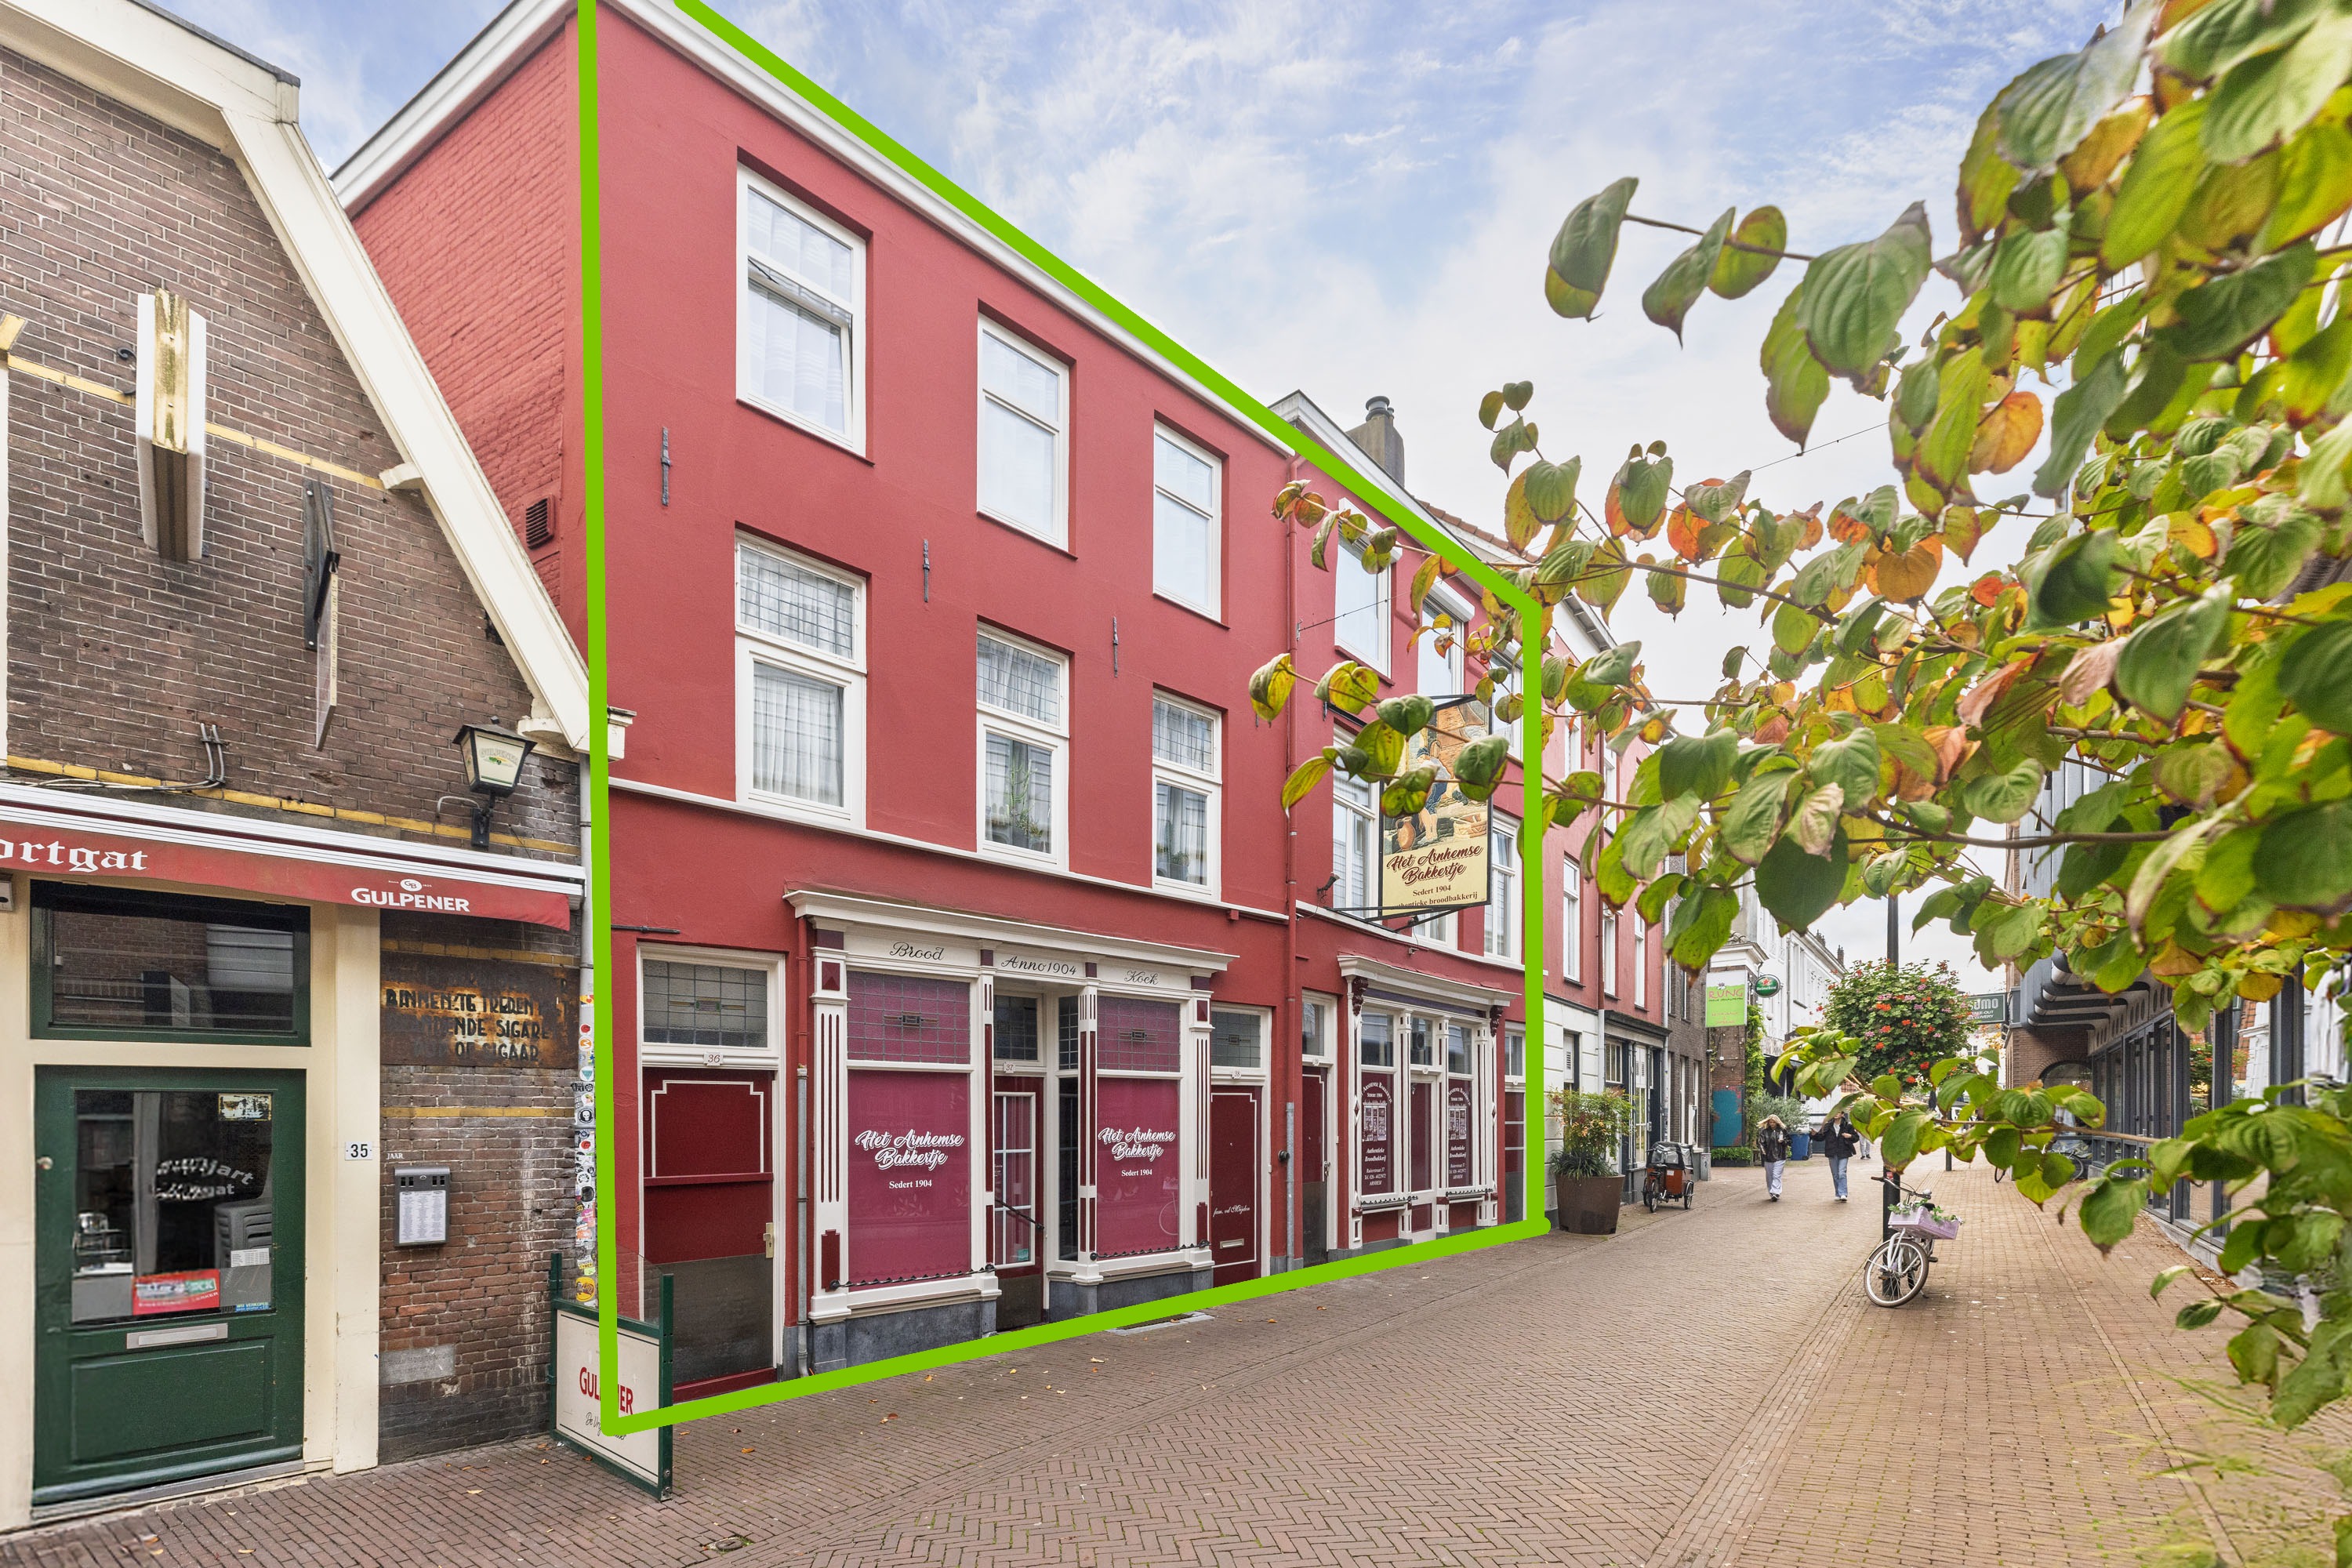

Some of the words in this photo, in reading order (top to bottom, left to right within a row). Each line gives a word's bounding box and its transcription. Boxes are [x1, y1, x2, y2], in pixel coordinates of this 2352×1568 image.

[1387, 855, 1416, 872] Het
[1417, 845, 1484, 867] Arnhemse
[1402, 862, 1467, 887] Bakkertje
[1413, 888, 1434, 897] Sedert
[1436, 885, 1451, 894] 1904
[1429, 891, 1478, 905] broodbakkerij
[351, 887, 470, 912] GULPENER
[890, 942, 944, 961] Brood
[1047, 962, 1076, 975] 1904
[1124, 971, 1159, 985] Koek
[1708, 988, 1744, 1000] RUNG
[707, 1054, 720, 1063] 36
[855, 1130, 892, 1151] Het
[893, 1129, 964, 1150] Arnhemse
[1098, 1127, 1123, 1145] Het
[1124, 1127, 1176, 1144] Arnhemse
[350, 1144, 368, 1158] 35
[874, 1147, 948, 1171] Bakkertje
[1112, 1142, 1163, 1162] Bakkertje
[915, 1179, 933, 1188] 1904
